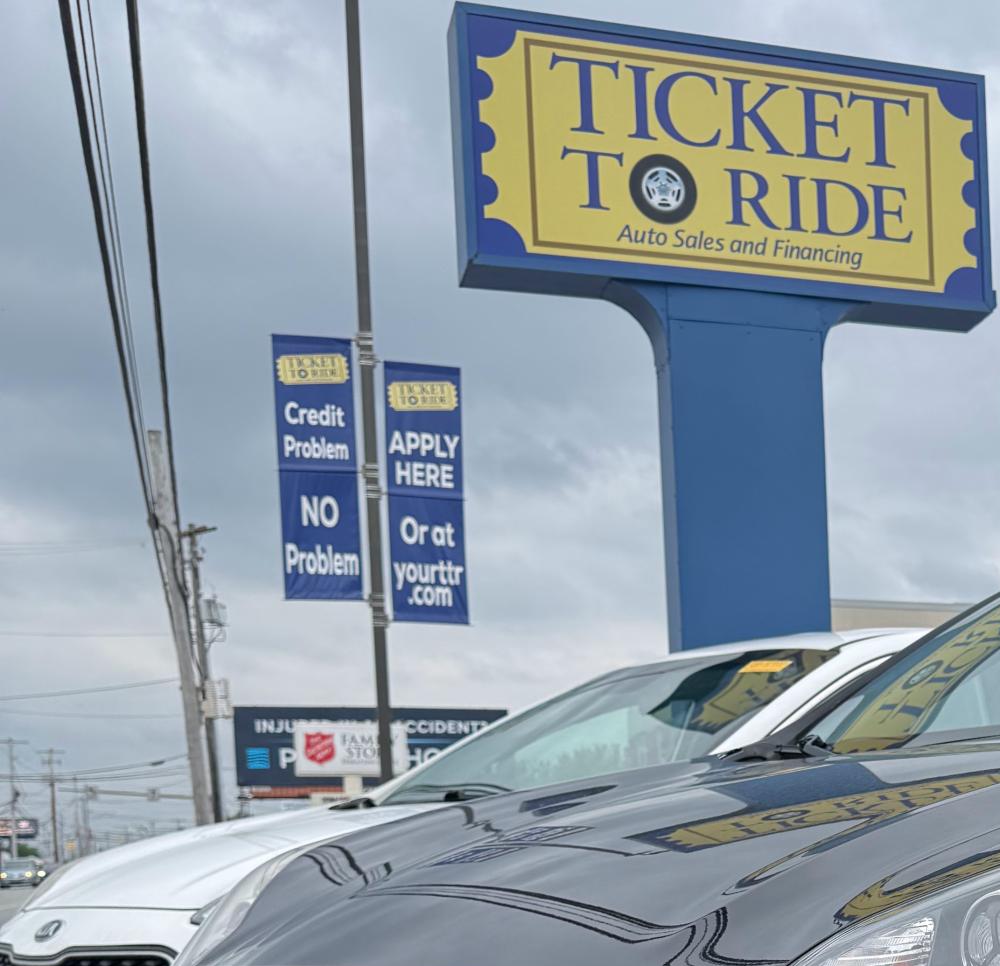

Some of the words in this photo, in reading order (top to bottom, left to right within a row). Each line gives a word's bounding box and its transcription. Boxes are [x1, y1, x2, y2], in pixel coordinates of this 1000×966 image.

[549, 52, 910, 169] TICKET
[724, 168, 913, 243] RIDE
[617, 224, 667, 246] Auto
[672, 229, 724, 251] Sales
[729, 237, 769, 256] and
[773, 239, 864, 270] Financing
[284, 400, 346, 428] Credit
[283, 434, 350, 460] Problem
[388, 430, 460, 459] APPLY
[394, 461, 455, 489] HERE
[300, 494, 340, 528] NO
[400, 515, 429, 545] Or
[431, 522, 456, 548] at
[284, 542, 360, 576] Problem
[393, 560, 464, 590] yourttr
[407, 585, 453, 608] .com
[254, 718, 294, 734] INJU
[405, 719, 490, 735] CCIDENT
